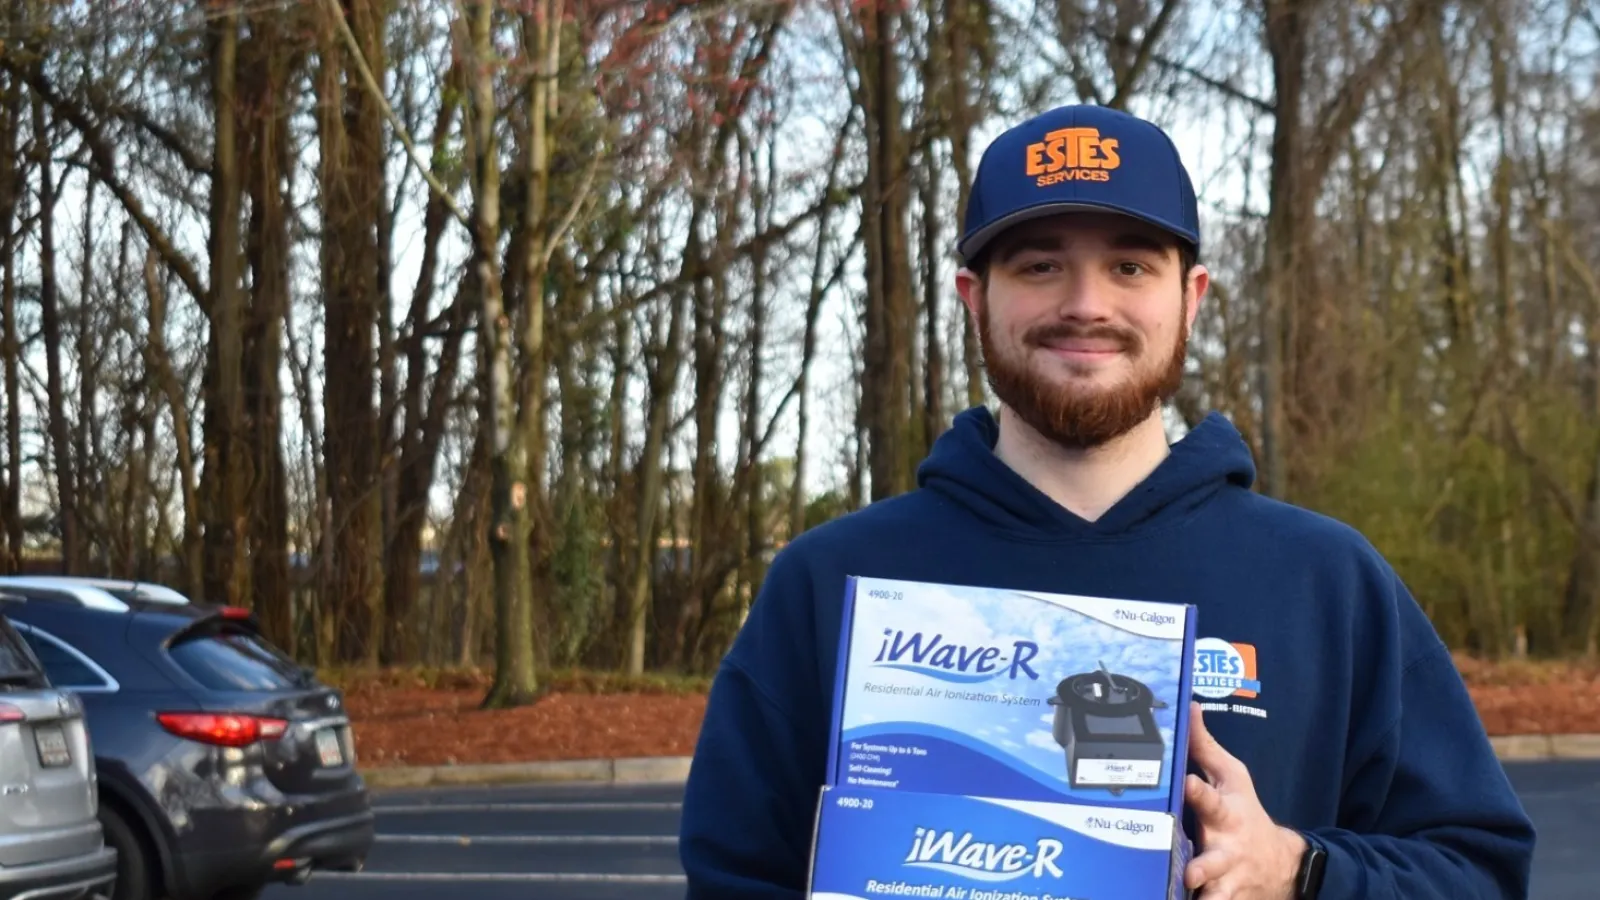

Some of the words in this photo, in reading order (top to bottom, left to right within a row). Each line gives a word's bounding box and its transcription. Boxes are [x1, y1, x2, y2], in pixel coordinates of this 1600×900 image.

[1026, 127, 1120, 176] ESTES
[1036, 169, 1110, 187] SERVICES
[868, 589, 904, 600] 4900-20
[1121, 609, 1176, 626] Nu-Calgon
[873, 627, 1040, 681] iWave-R
[1193, 649, 1240, 675] STES
[1192, 675, 1243, 689] ERVICES
[863, 682, 925, 697] Residential
[925, 687, 942, 698] Air
[944, 689, 999, 704] Ionization
[1000, 693, 1041, 707] System
[837, 797, 873, 809] 4900-20
[1094, 818, 1155, 835] Nu-Calgon
[905, 827, 1064, 879] iWave-R
[866, 880, 944, 898] Residential
[945, 886, 967, 900] Air
